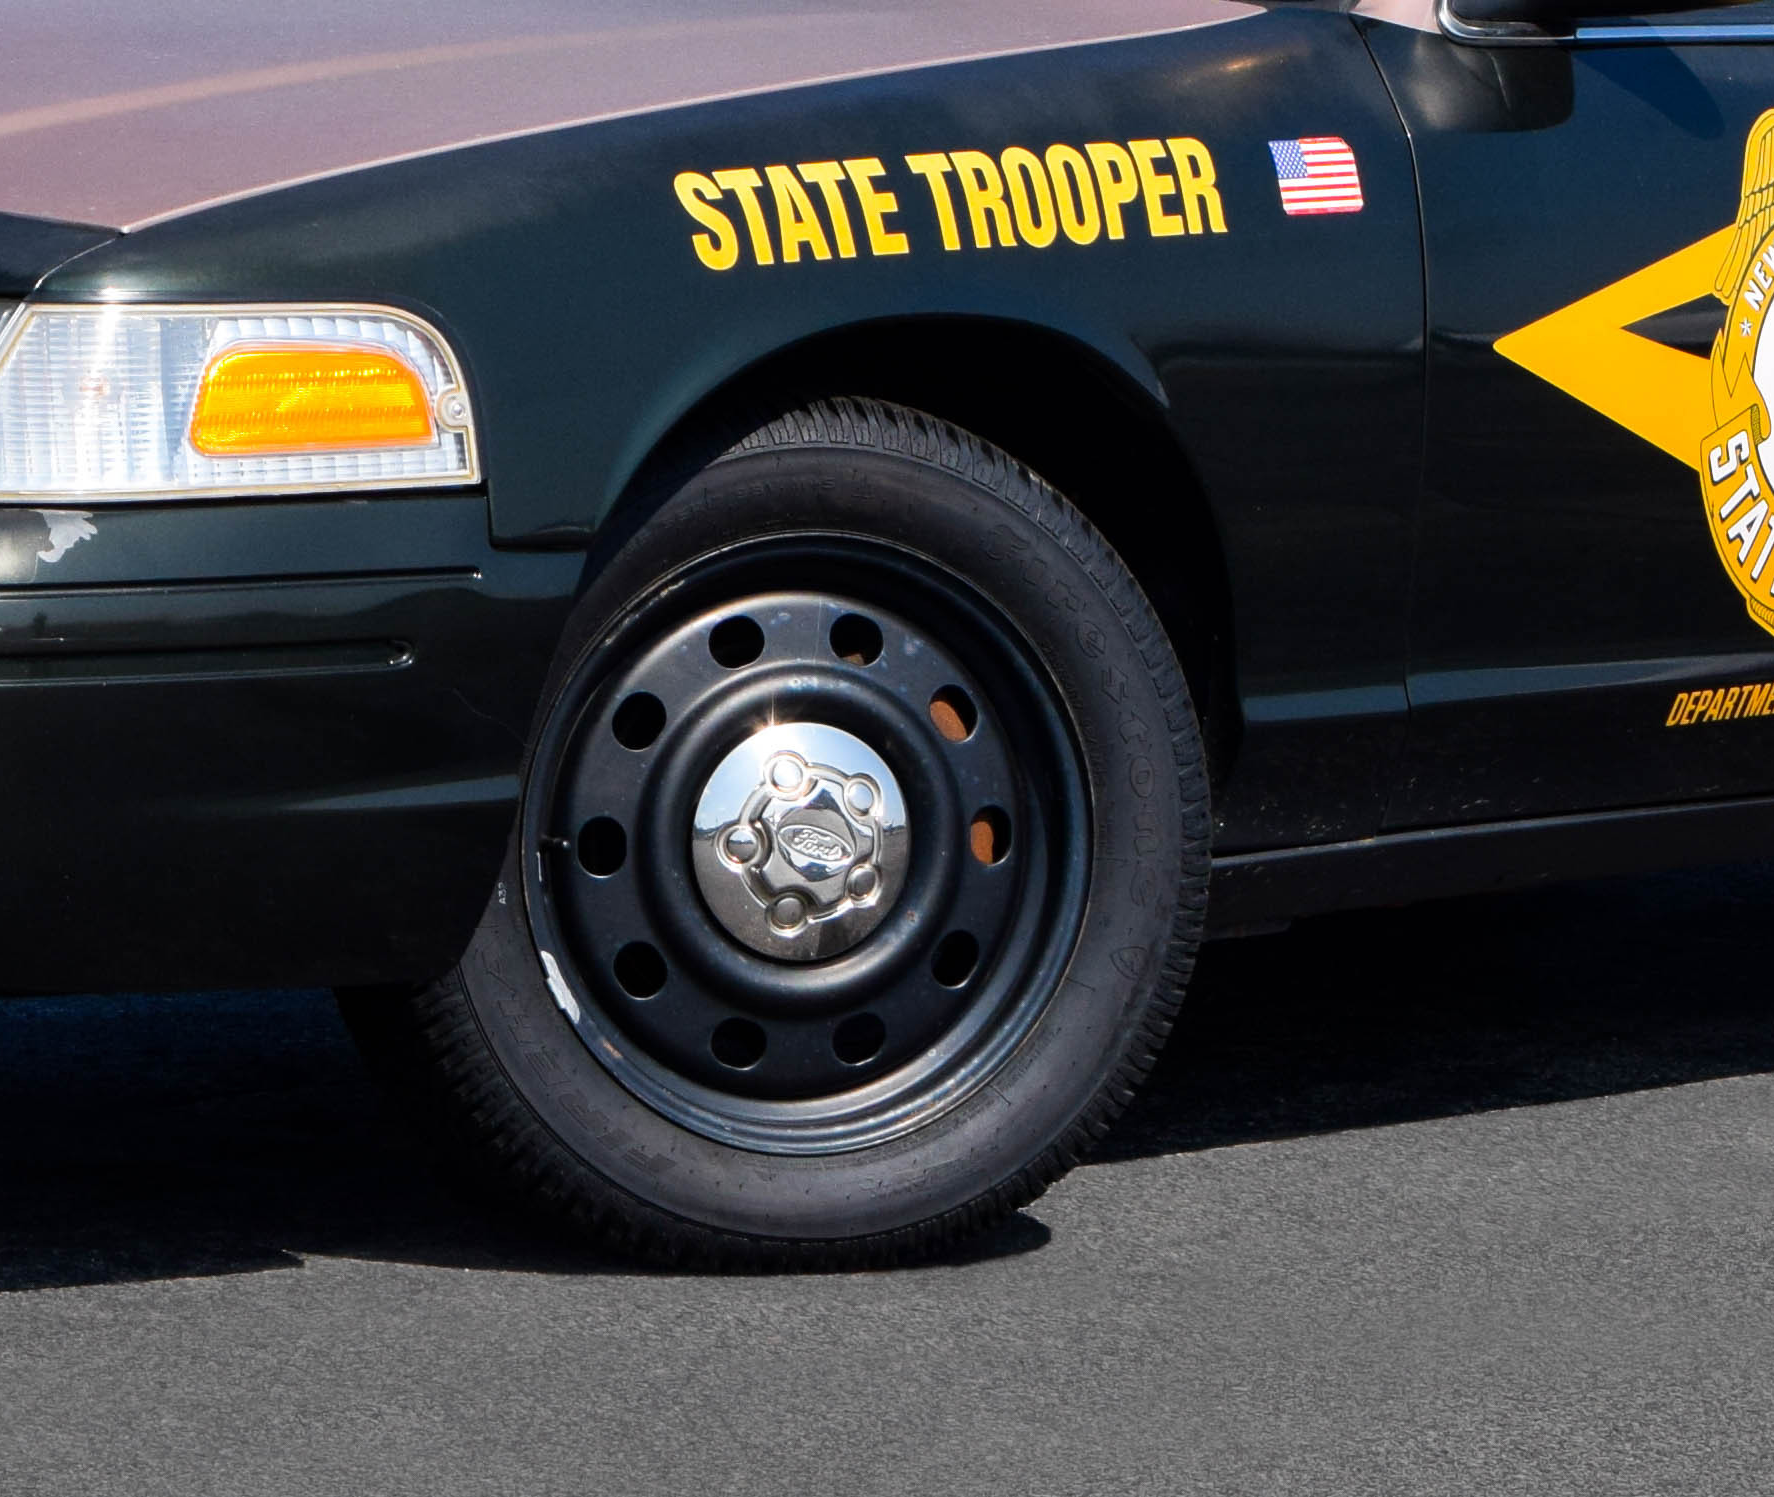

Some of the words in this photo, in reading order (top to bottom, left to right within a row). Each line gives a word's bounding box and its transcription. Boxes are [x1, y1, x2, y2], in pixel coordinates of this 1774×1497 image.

[674, 157, 910, 271] STATE
[904, 136, 1228, 252] TROOPER
[791, 829, 843, 860] Ford
